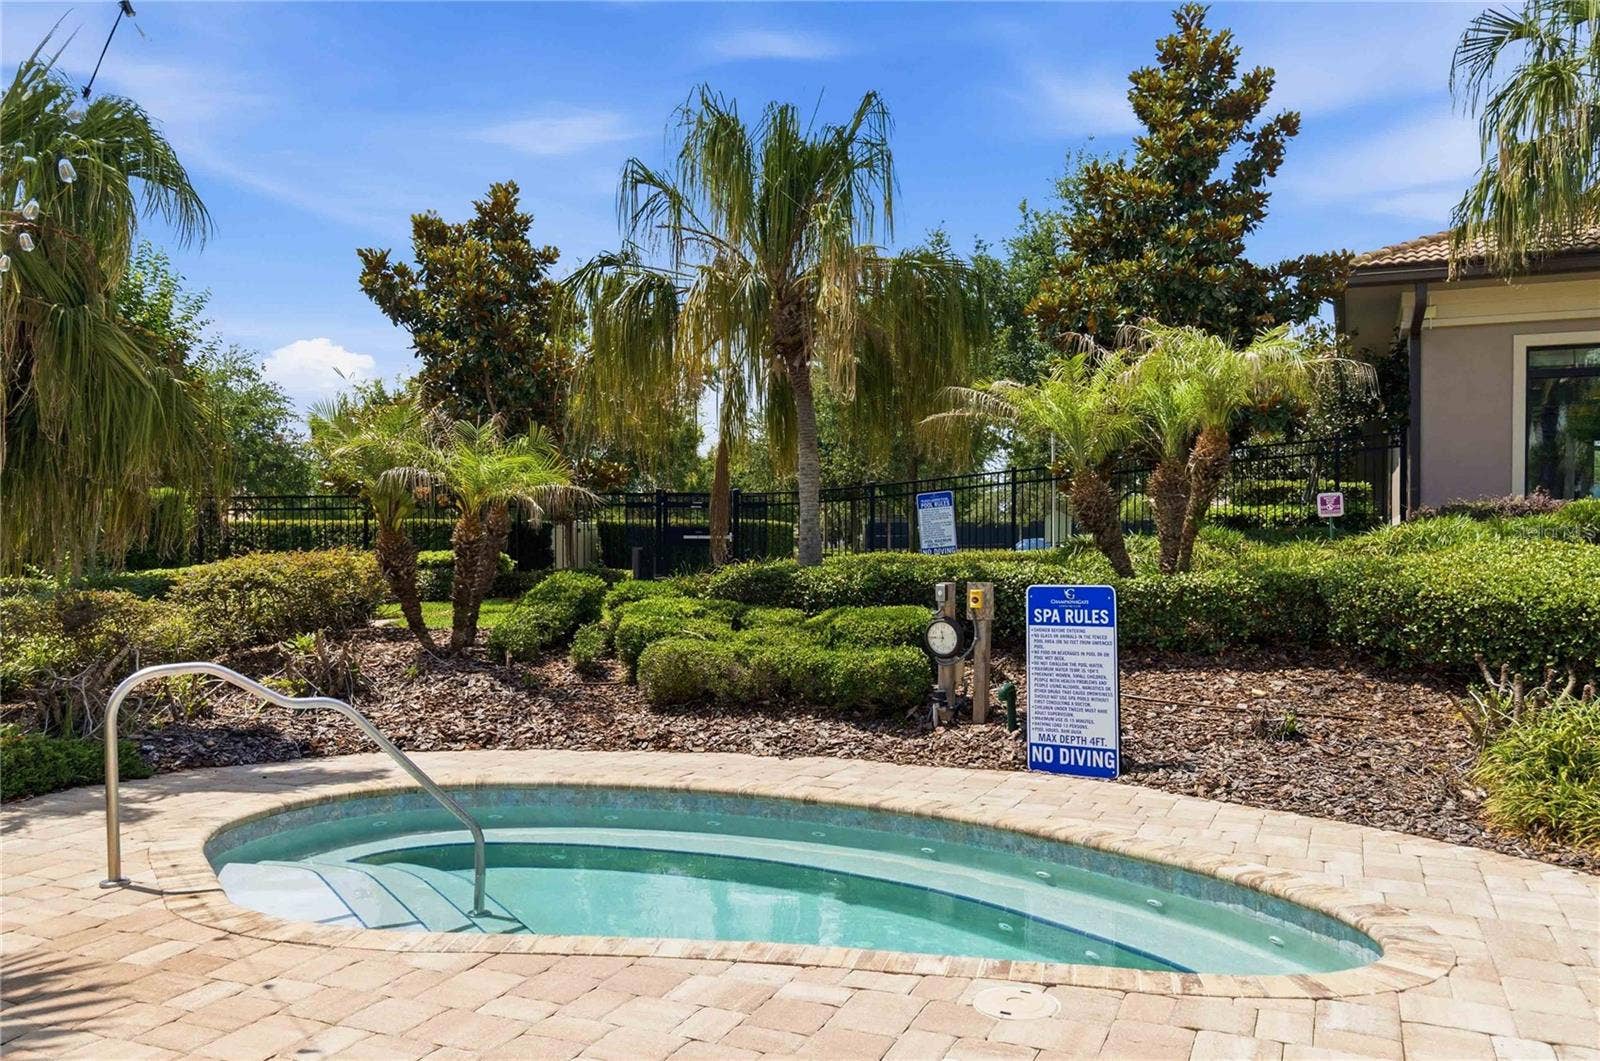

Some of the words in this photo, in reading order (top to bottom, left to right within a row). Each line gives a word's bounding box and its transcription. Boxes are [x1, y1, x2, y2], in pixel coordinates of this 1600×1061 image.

[1034, 608, 1060, 623] SPA
[1065, 609, 1109, 624] RULES
[1039, 734, 1056, 743] MAX
[1060, 735, 1087, 745] DEPTH
[1089, 737, 1107, 747] 4FT.
[1032, 746, 1053, 763] NO
[1060, 748, 1115, 769] DIVING
